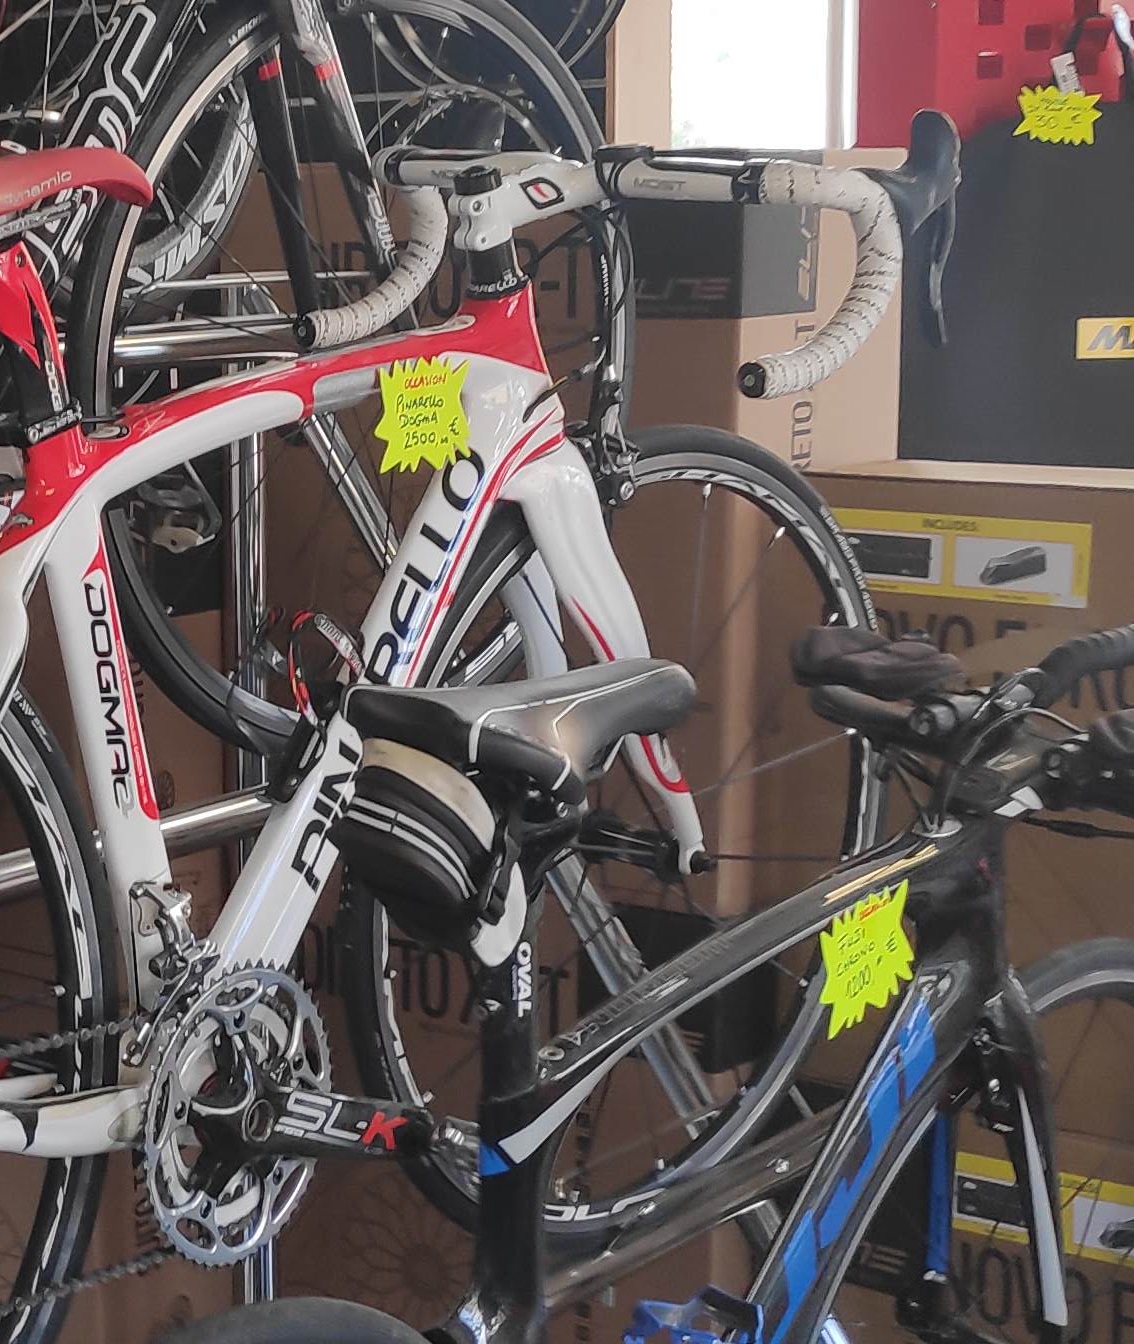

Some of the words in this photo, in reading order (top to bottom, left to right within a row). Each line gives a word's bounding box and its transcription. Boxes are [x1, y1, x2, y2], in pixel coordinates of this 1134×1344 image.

[395, 393, 445, 414] PINARELLO
[398, 411, 439, 429] DOGMA
[515, 941, 534, 1018] OVAL
